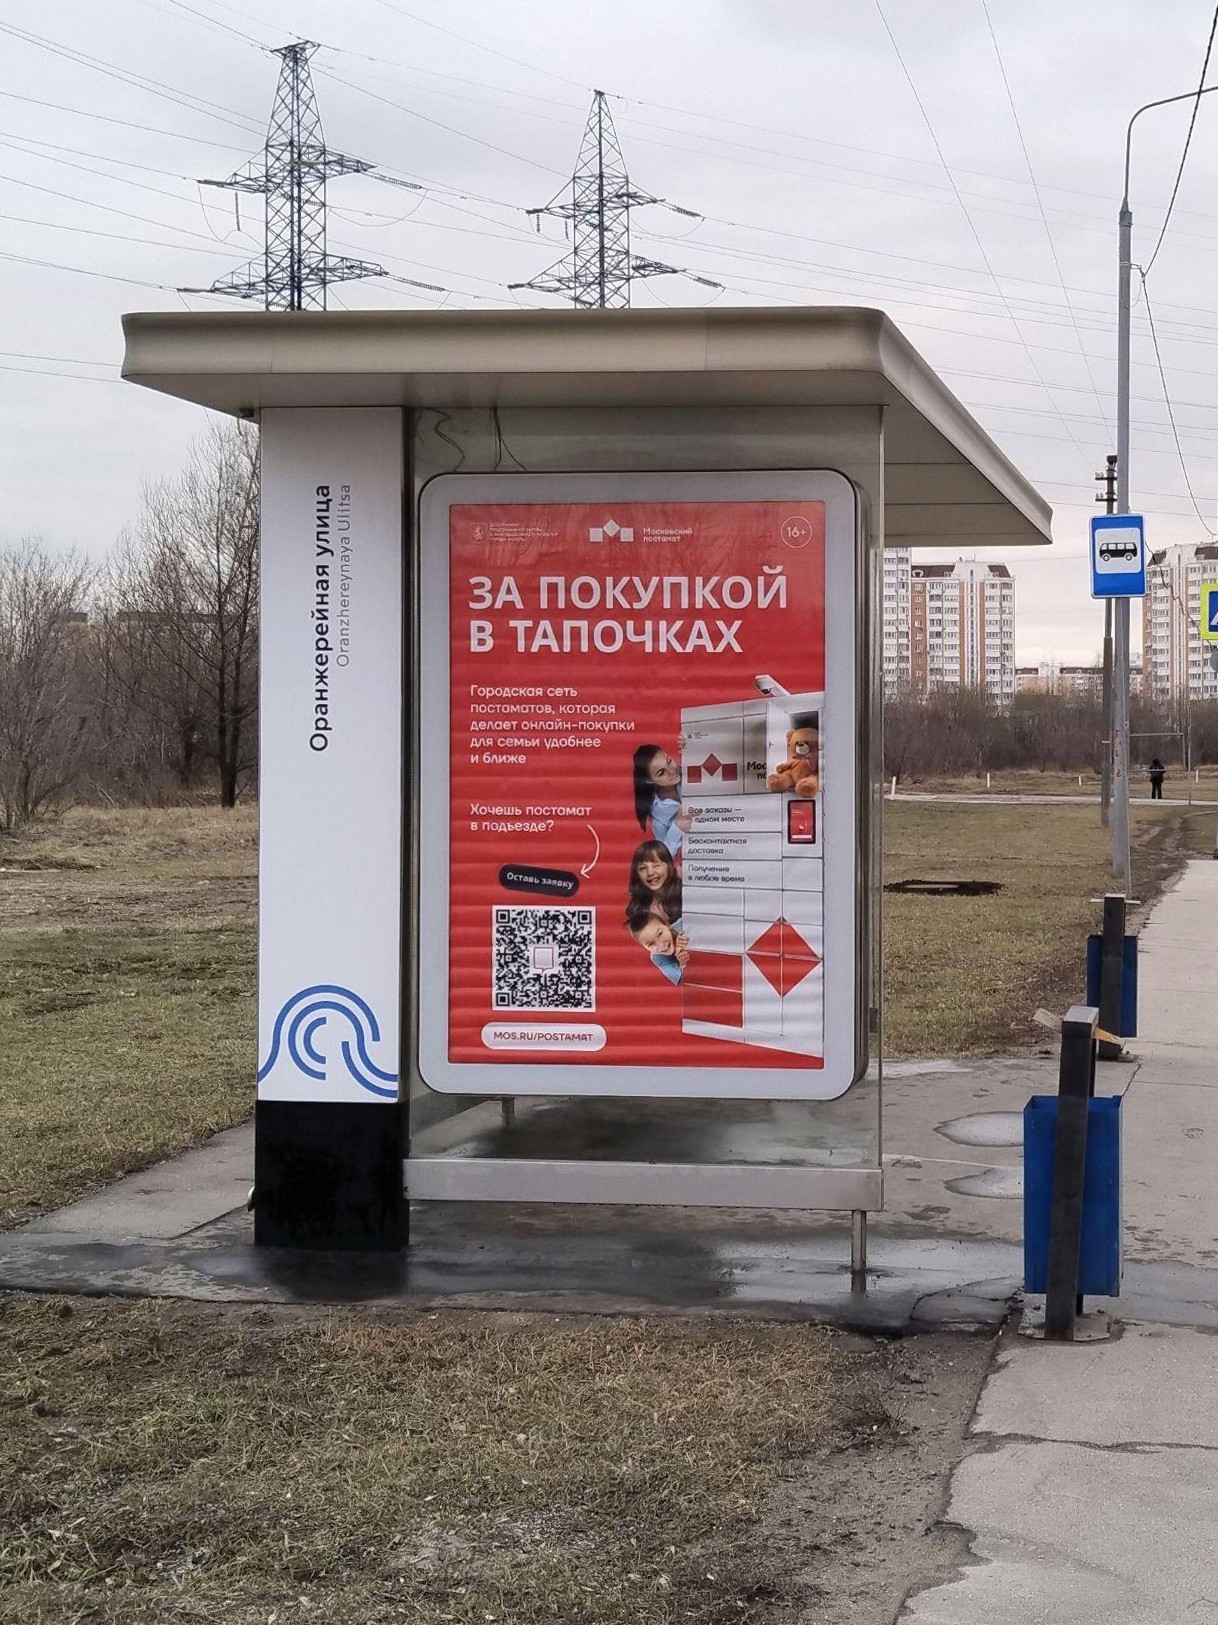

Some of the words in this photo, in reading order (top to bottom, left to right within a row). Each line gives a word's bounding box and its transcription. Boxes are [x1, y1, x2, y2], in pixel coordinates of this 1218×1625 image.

[337, 484, 350, 531] Ulitsa
[315, 485, 334, 557] улица
[643, 526, 693, 536] Московский
[786, 526, 807, 538] 16+
[468, 576, 524, 609] ЗА
[540, 565, 787, 609] ПОКУПКОЙ
[336, 536, 353, 667] Oranzhereynaya
[470, 620, 494, 653] В
[509, 620, 743, 653] ТАПОЧКАХ
[309, 564, 333, 752] Оранжерейная
[470, 685, 543, 699] Городская
[547, 687, 578, 697] сеть
[470, 703, 555, 715] постаматов,
[559, 704, 616, 716] которая
[470, 721, 517, 732] делает
[521, 719, 635, 733] онлайн-покупки
[470, 737, 492, 748] для
[497, 737, 540, 748] семьи
[544, 735, 601, 750] удобнее
[470, 753, 479, 763] и
[482, 752, 527, 764] ближе
[470, 803, 522, 816] Хочешь
[526, 805, 592, 816] постамат
[470, 823, 478, 831] в
[482, 820, 554, 832] подъезде?
[506, 872, 540, 884] Оставь
[541, 878, 574, 890] заявку
[493, 1031, 594, 1042] MOS.RU/POSTAMAT
